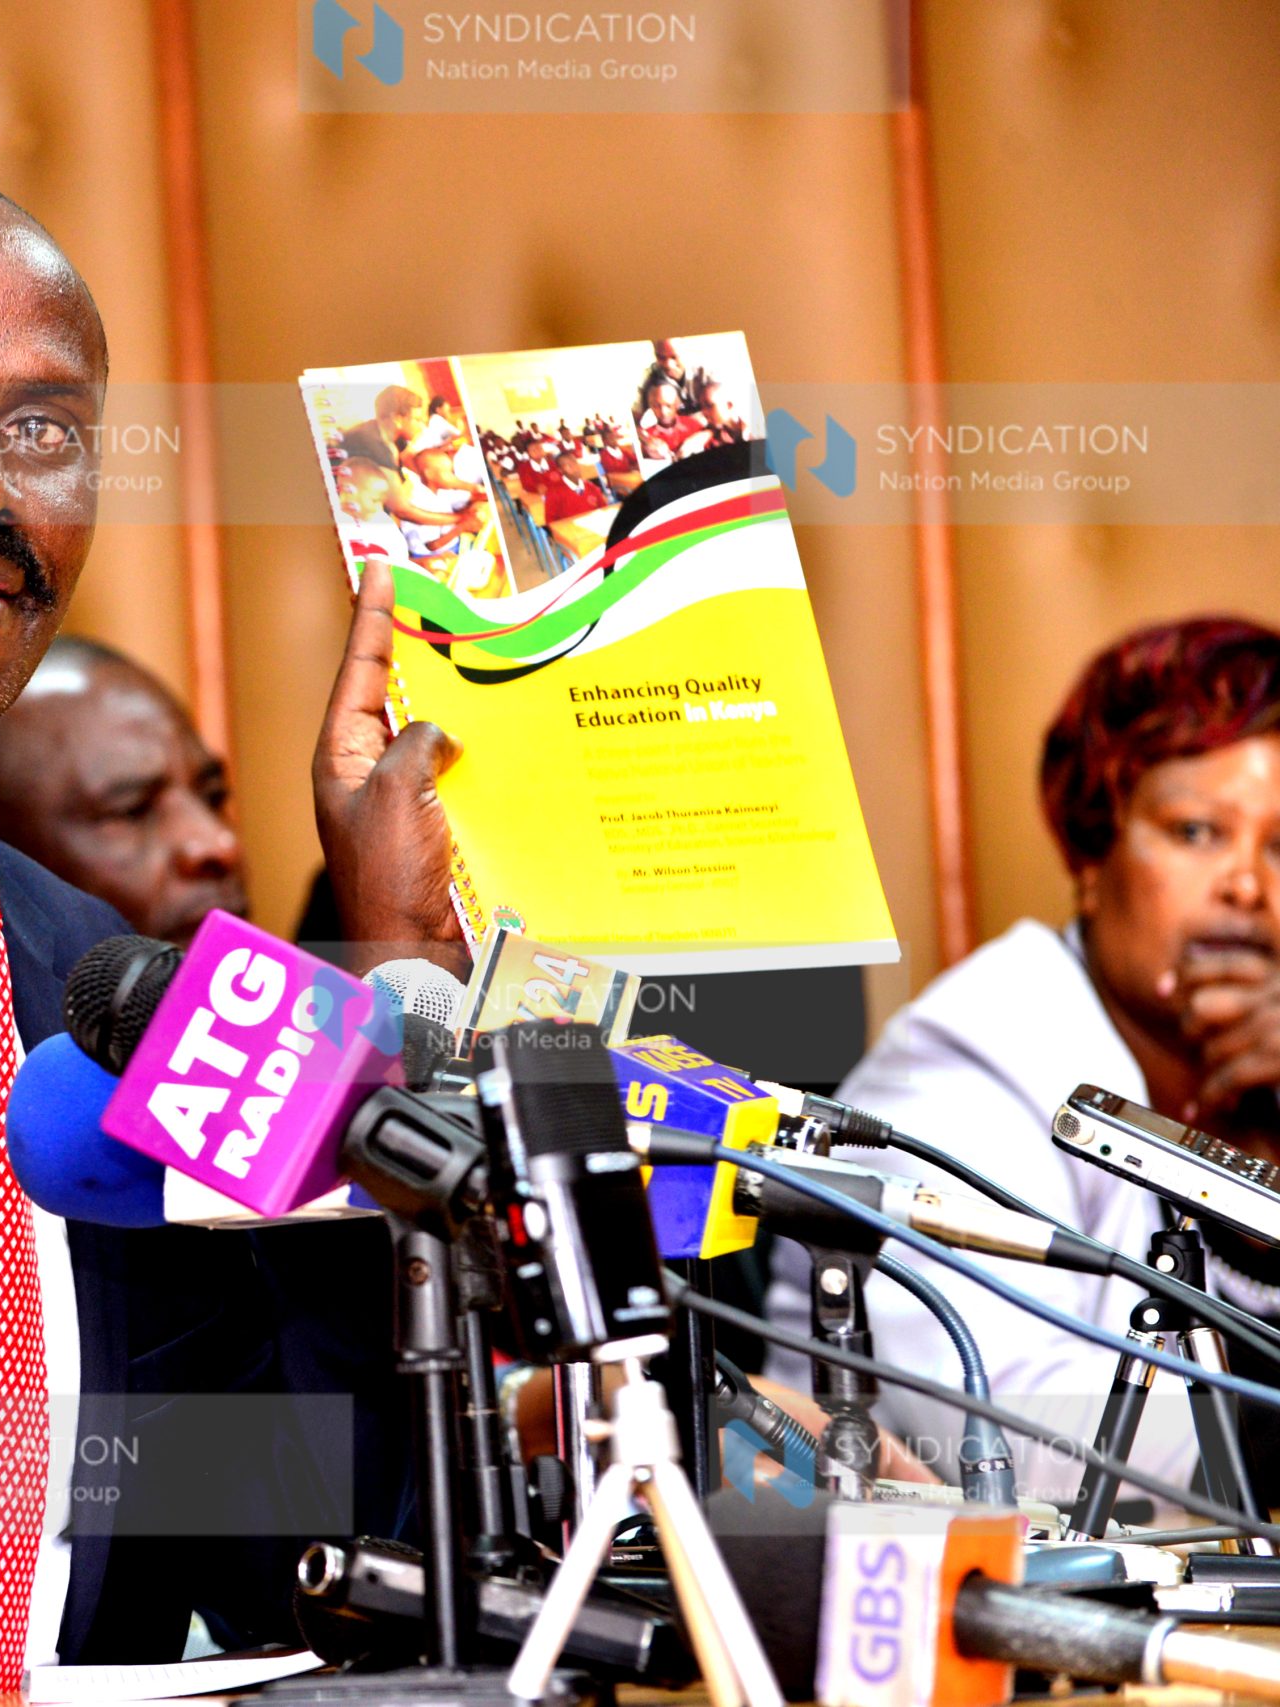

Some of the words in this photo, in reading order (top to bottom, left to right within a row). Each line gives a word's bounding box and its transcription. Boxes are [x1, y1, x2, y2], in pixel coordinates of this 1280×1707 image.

[569, 682, 680, 702] Enhancing
[685, 674, 761, 695] Quality
[576, 707, 681, 728] Education
[600, 813, 627, 824] Prof.
[631, 811, 663, 822] Jacob
[632, 868, 651, 878] Mr.
[654, 866, 691, 877] Wilson
[147, 948, 286, 1160] ATG
[212, 985, 334, 1180] RADIO
[701, 1076, 756, 1100] TV
[849, 1540, 907, 1686] GBS
